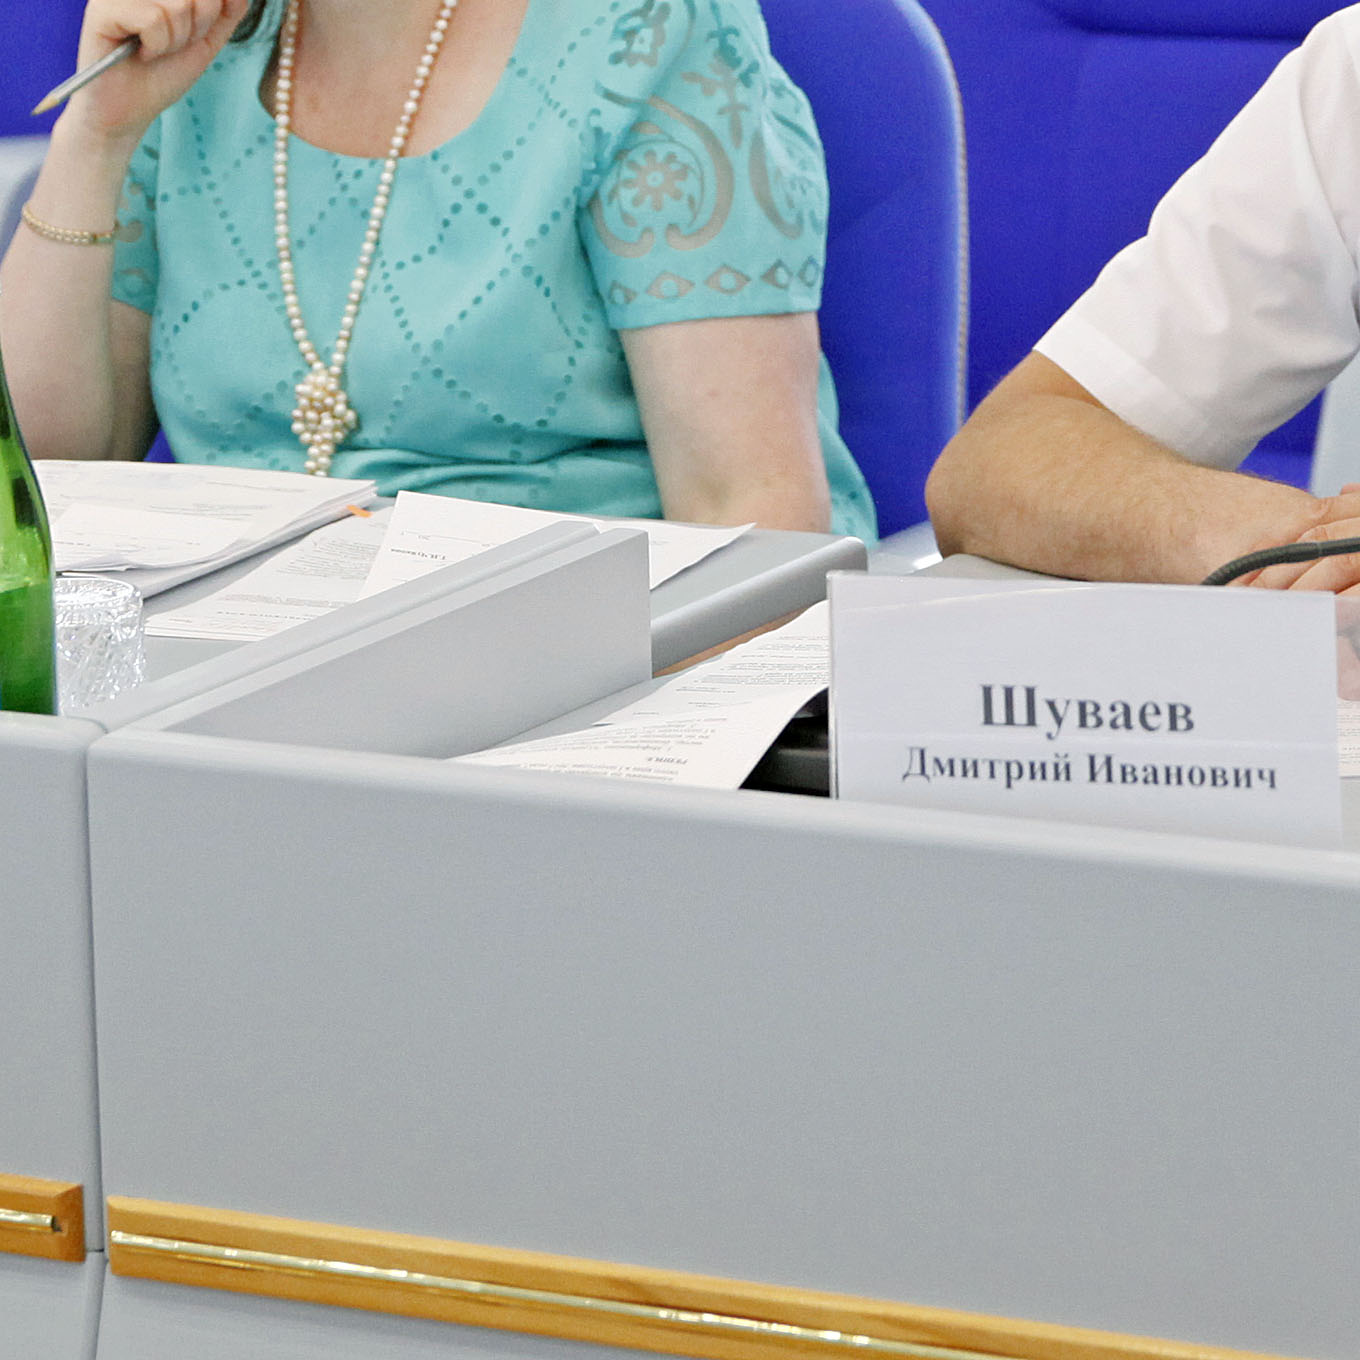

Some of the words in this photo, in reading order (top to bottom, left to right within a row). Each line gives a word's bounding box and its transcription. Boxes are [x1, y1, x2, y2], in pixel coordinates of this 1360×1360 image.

[978, 683, 1196, 740] Шуваев
[901, 746, 1073, 789] Дмитрий
[1087, 754, 1278, 790] Иванович
